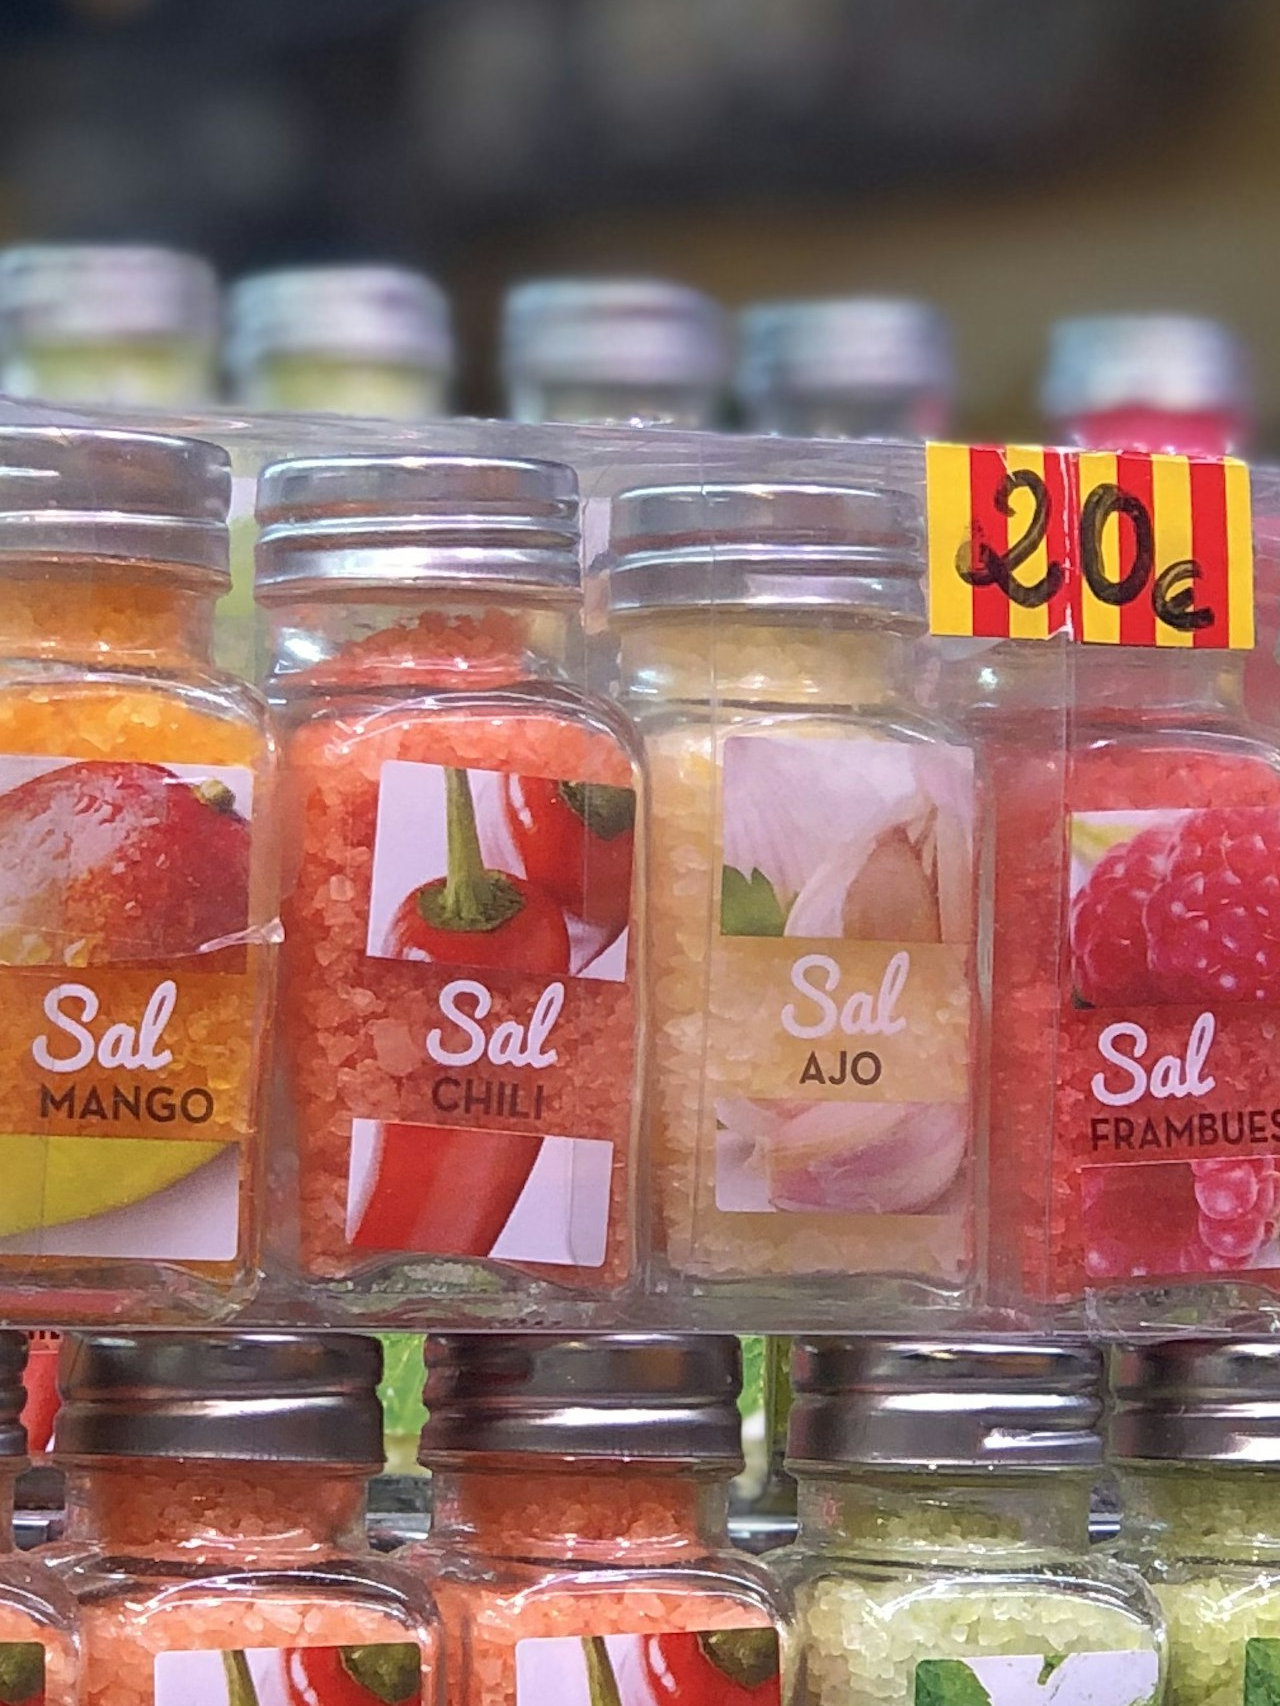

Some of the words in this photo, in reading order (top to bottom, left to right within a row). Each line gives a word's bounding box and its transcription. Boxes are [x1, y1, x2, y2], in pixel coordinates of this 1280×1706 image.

[33, 980, 178, 1072] Sal
[426, 979, 565, 1069] Sal
[781, 950, 912, 1039] Sal
[431, 1077, 544, 1121] CHILI
[798, 1052, 882, 1086] AJO
[1091, 1011, 1216, 1106] Sal
[38, 1084, 214, 1124] MANGO
